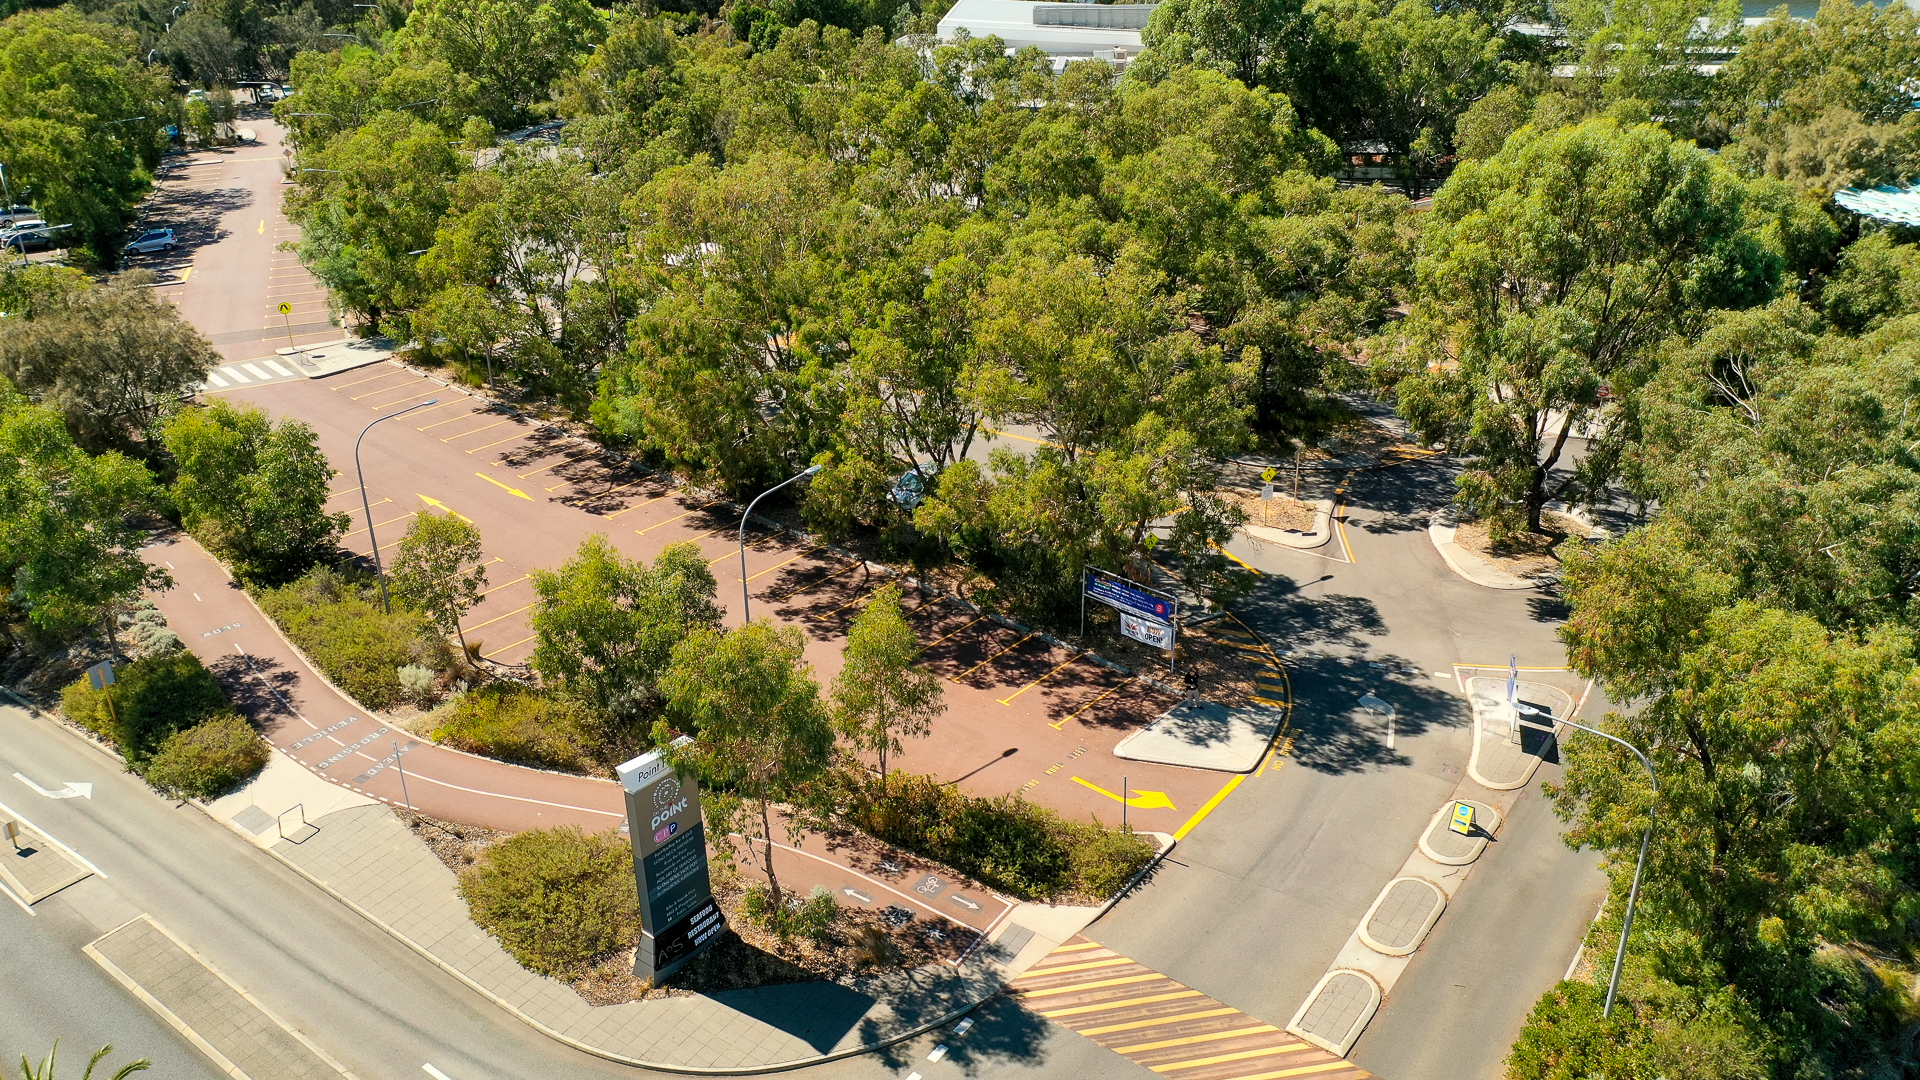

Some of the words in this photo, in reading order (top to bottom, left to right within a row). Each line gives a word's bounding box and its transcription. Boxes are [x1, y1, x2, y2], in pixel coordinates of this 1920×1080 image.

[203, 622, 241, 638] SLOW
[1144, 633, 1163, 644] OPEN!
[292, 715, 358, 750] VEHICLE
[318, 726, 389, 770] CROSSING
[1069, 747, 1087, 760] LEFT
[366, 745, 410, 776] AHEAD
[1043, 762, 1065, 776] TURN
[1270, 760, 1284, 771] NO
[637, 763, 660, 783] Point
[1021, 778, 1040, 792] ONLY
[655, 823, 676, 842] CPP
[690, 904, 713, 925] SEAFOOD
[687, 911, 719, 939] RESTAURANT
[694, 931, 708, 947] NOW
[707, 922, 721, 937] OPEN
